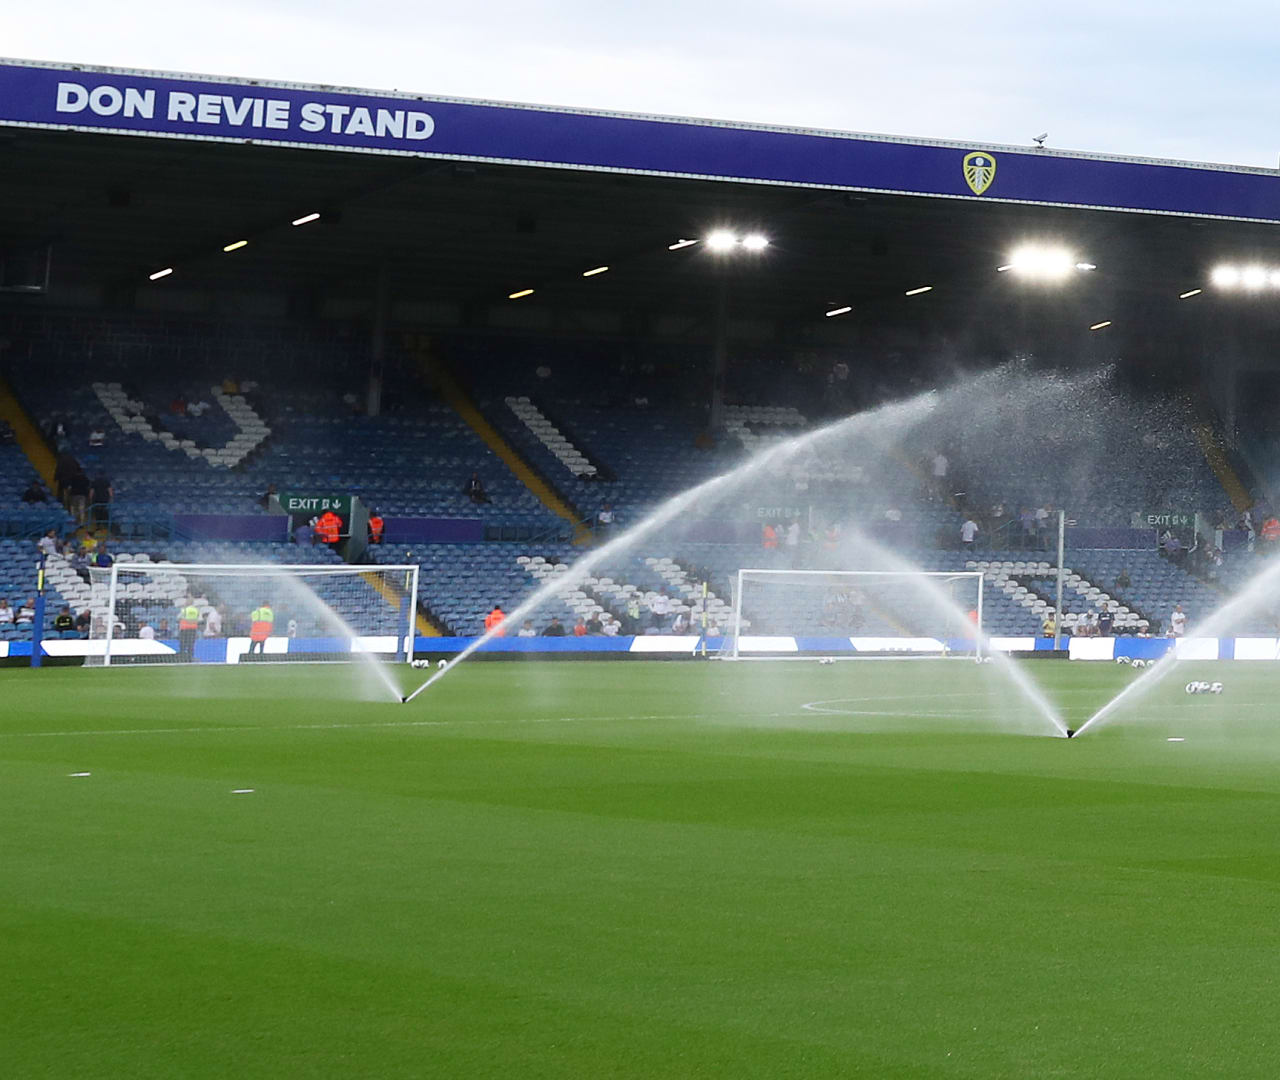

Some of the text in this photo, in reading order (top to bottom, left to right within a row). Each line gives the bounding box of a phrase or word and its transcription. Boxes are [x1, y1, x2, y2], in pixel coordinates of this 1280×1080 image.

[57, 83, 434, 140] DON REVIE STAND
[288, 498, 319, 510] EXIT
[758, 507, 782, 519] EXIT
[1147, 515, 1171, 526] EXIT
